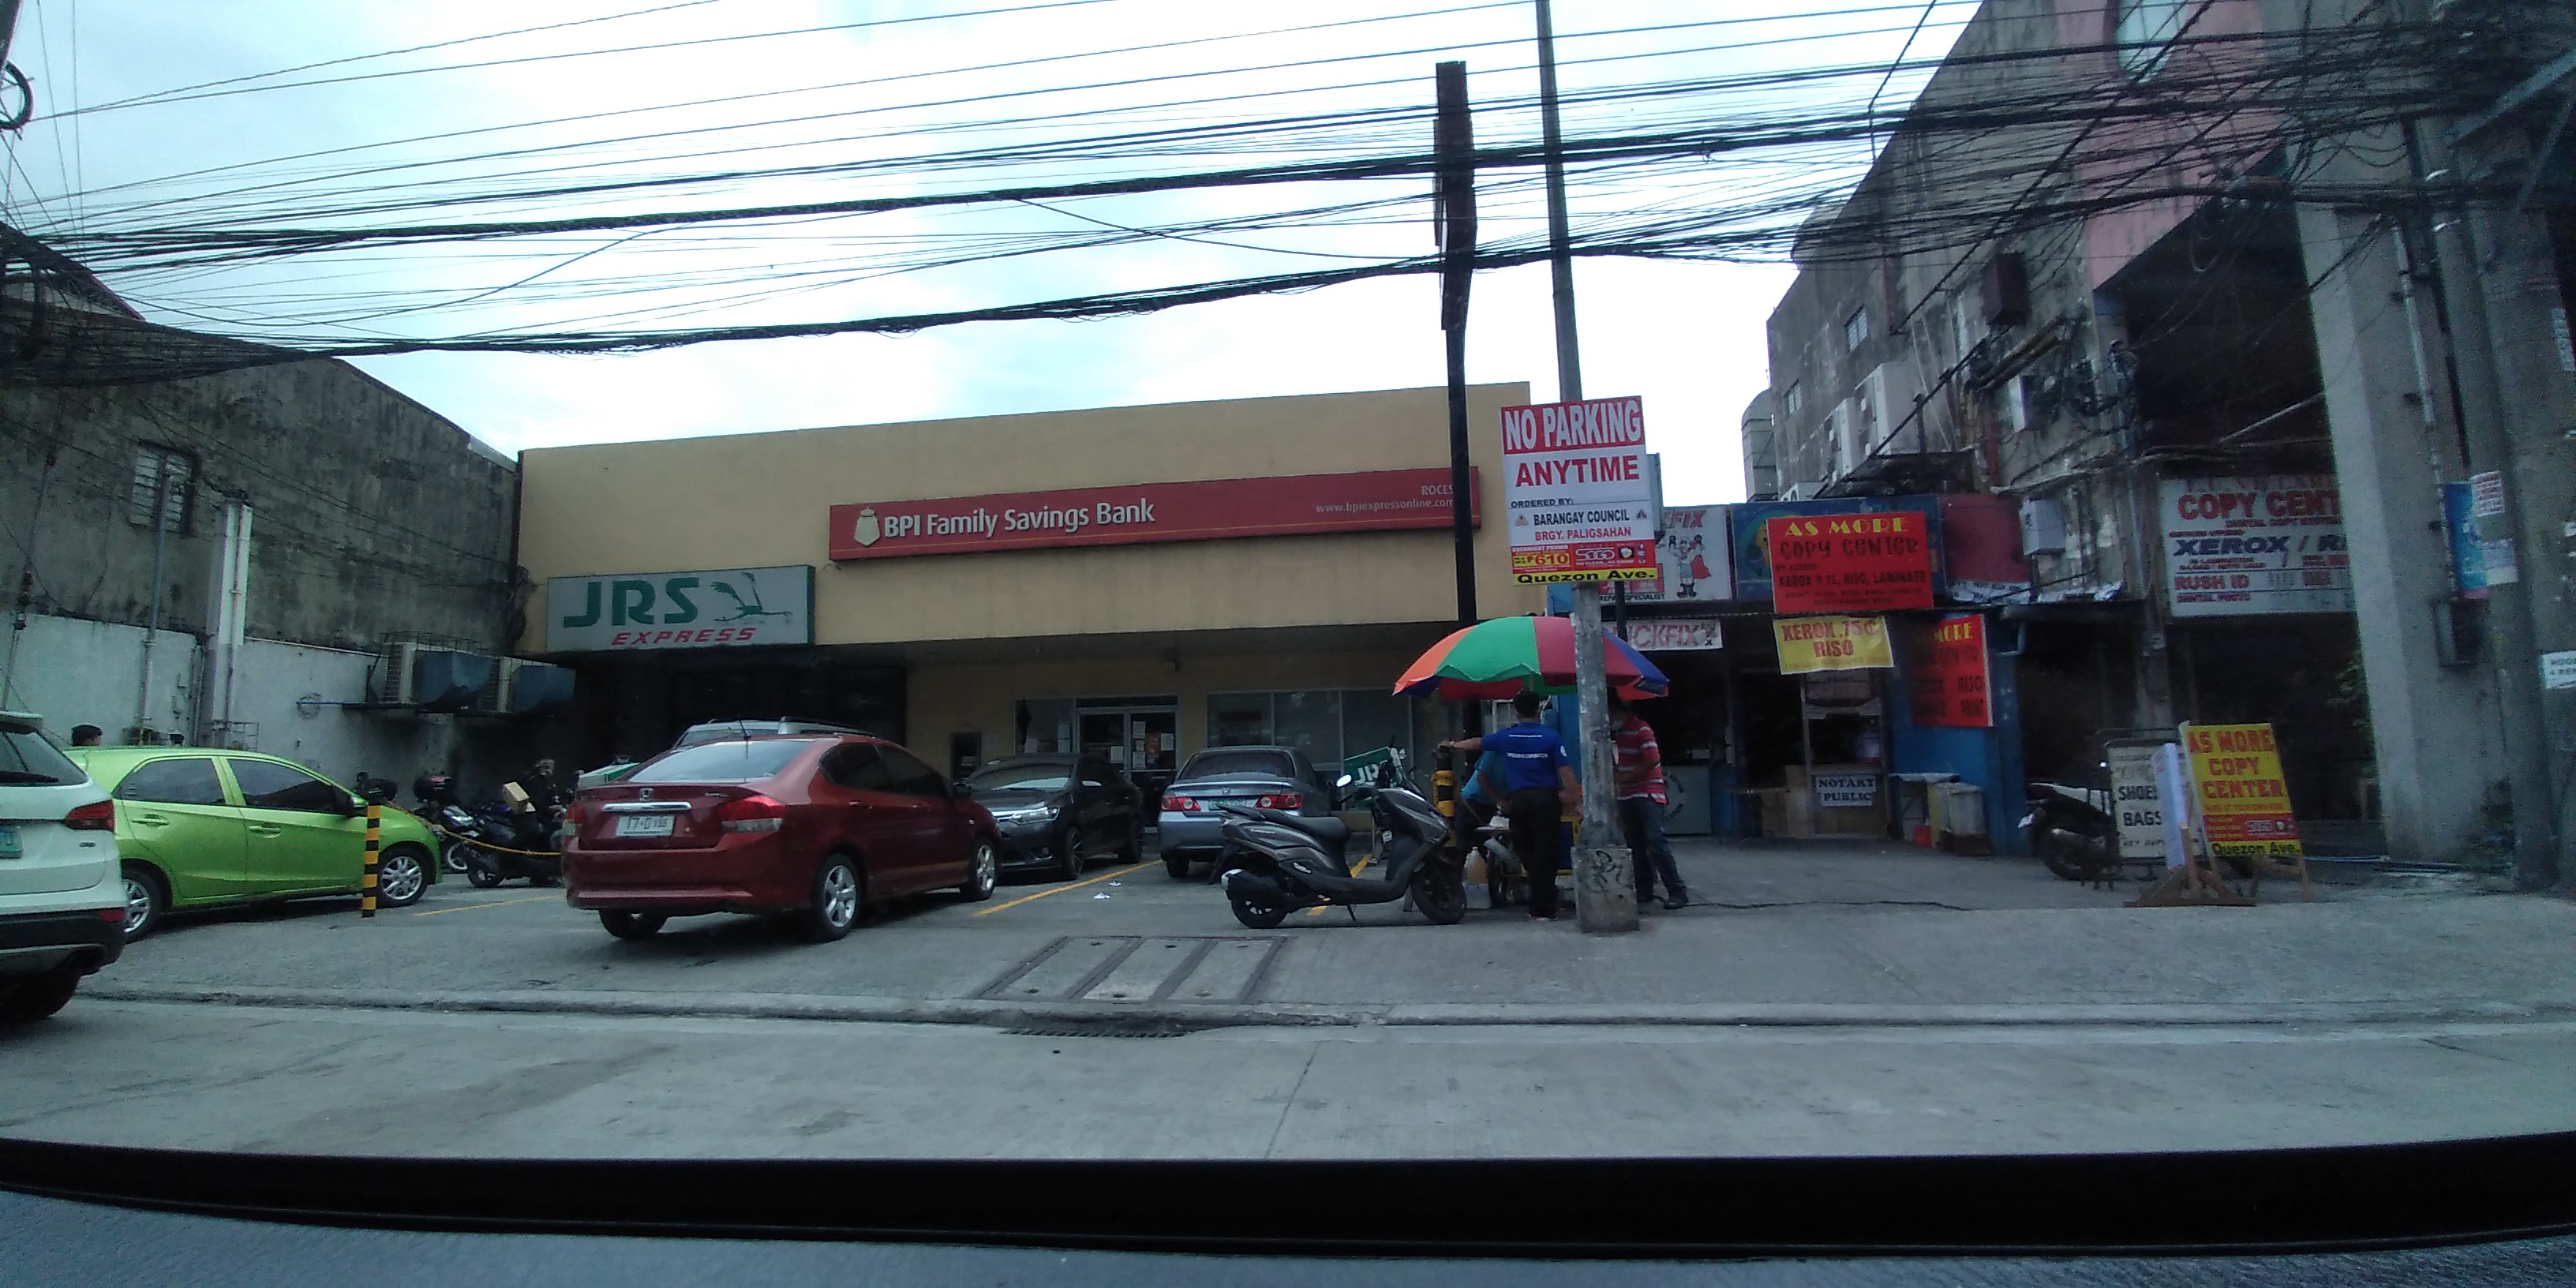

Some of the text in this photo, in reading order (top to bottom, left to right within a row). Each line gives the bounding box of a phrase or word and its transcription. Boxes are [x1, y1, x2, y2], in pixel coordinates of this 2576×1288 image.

[1504, 400, 1642, 451] NO PARKING
[1515, 455, 1640, 488] ANYTIME
[1511, 499, 1556, 508] ORDERED
[2177, 491, 2340, 520] COPY CENT
[885, 497, 1155, 538] BPI Family Savings Bank
[1533, 509, 1630, 526] BARANGAY COUNCIL
[1535, 527, 1631, 541] BRGY. PALIGSAHAN
[1785, 518, 1908, 537] AS MORE
[2173, 537, 2290, 556] XEROX
[1517, 570, 1654, 584] Quezon Ave.
[1874, 570, 1925, 584] LAMINATE
[2174, 575, 2226, 590] RUSH
[2230, 575, 2250, 589] ID
[564, 577, 700, 627] JRS
[612, 627, 757, 646] EXPRESS
[1781, 622, 1835, 641] XEROX
[1814, 639, 1854, 657] RISO
[2188, 729, 2273, 753] AS MORE
[2208, 757, 2259, 776] COPY
[1824, 792, 1871, 801] PUBLIC
[2118, 784, 2158, 801] SHOE
[2203, 779, 2284, 798] CENTER
[2212, 842, 2301, 854] Quezon Ave.
